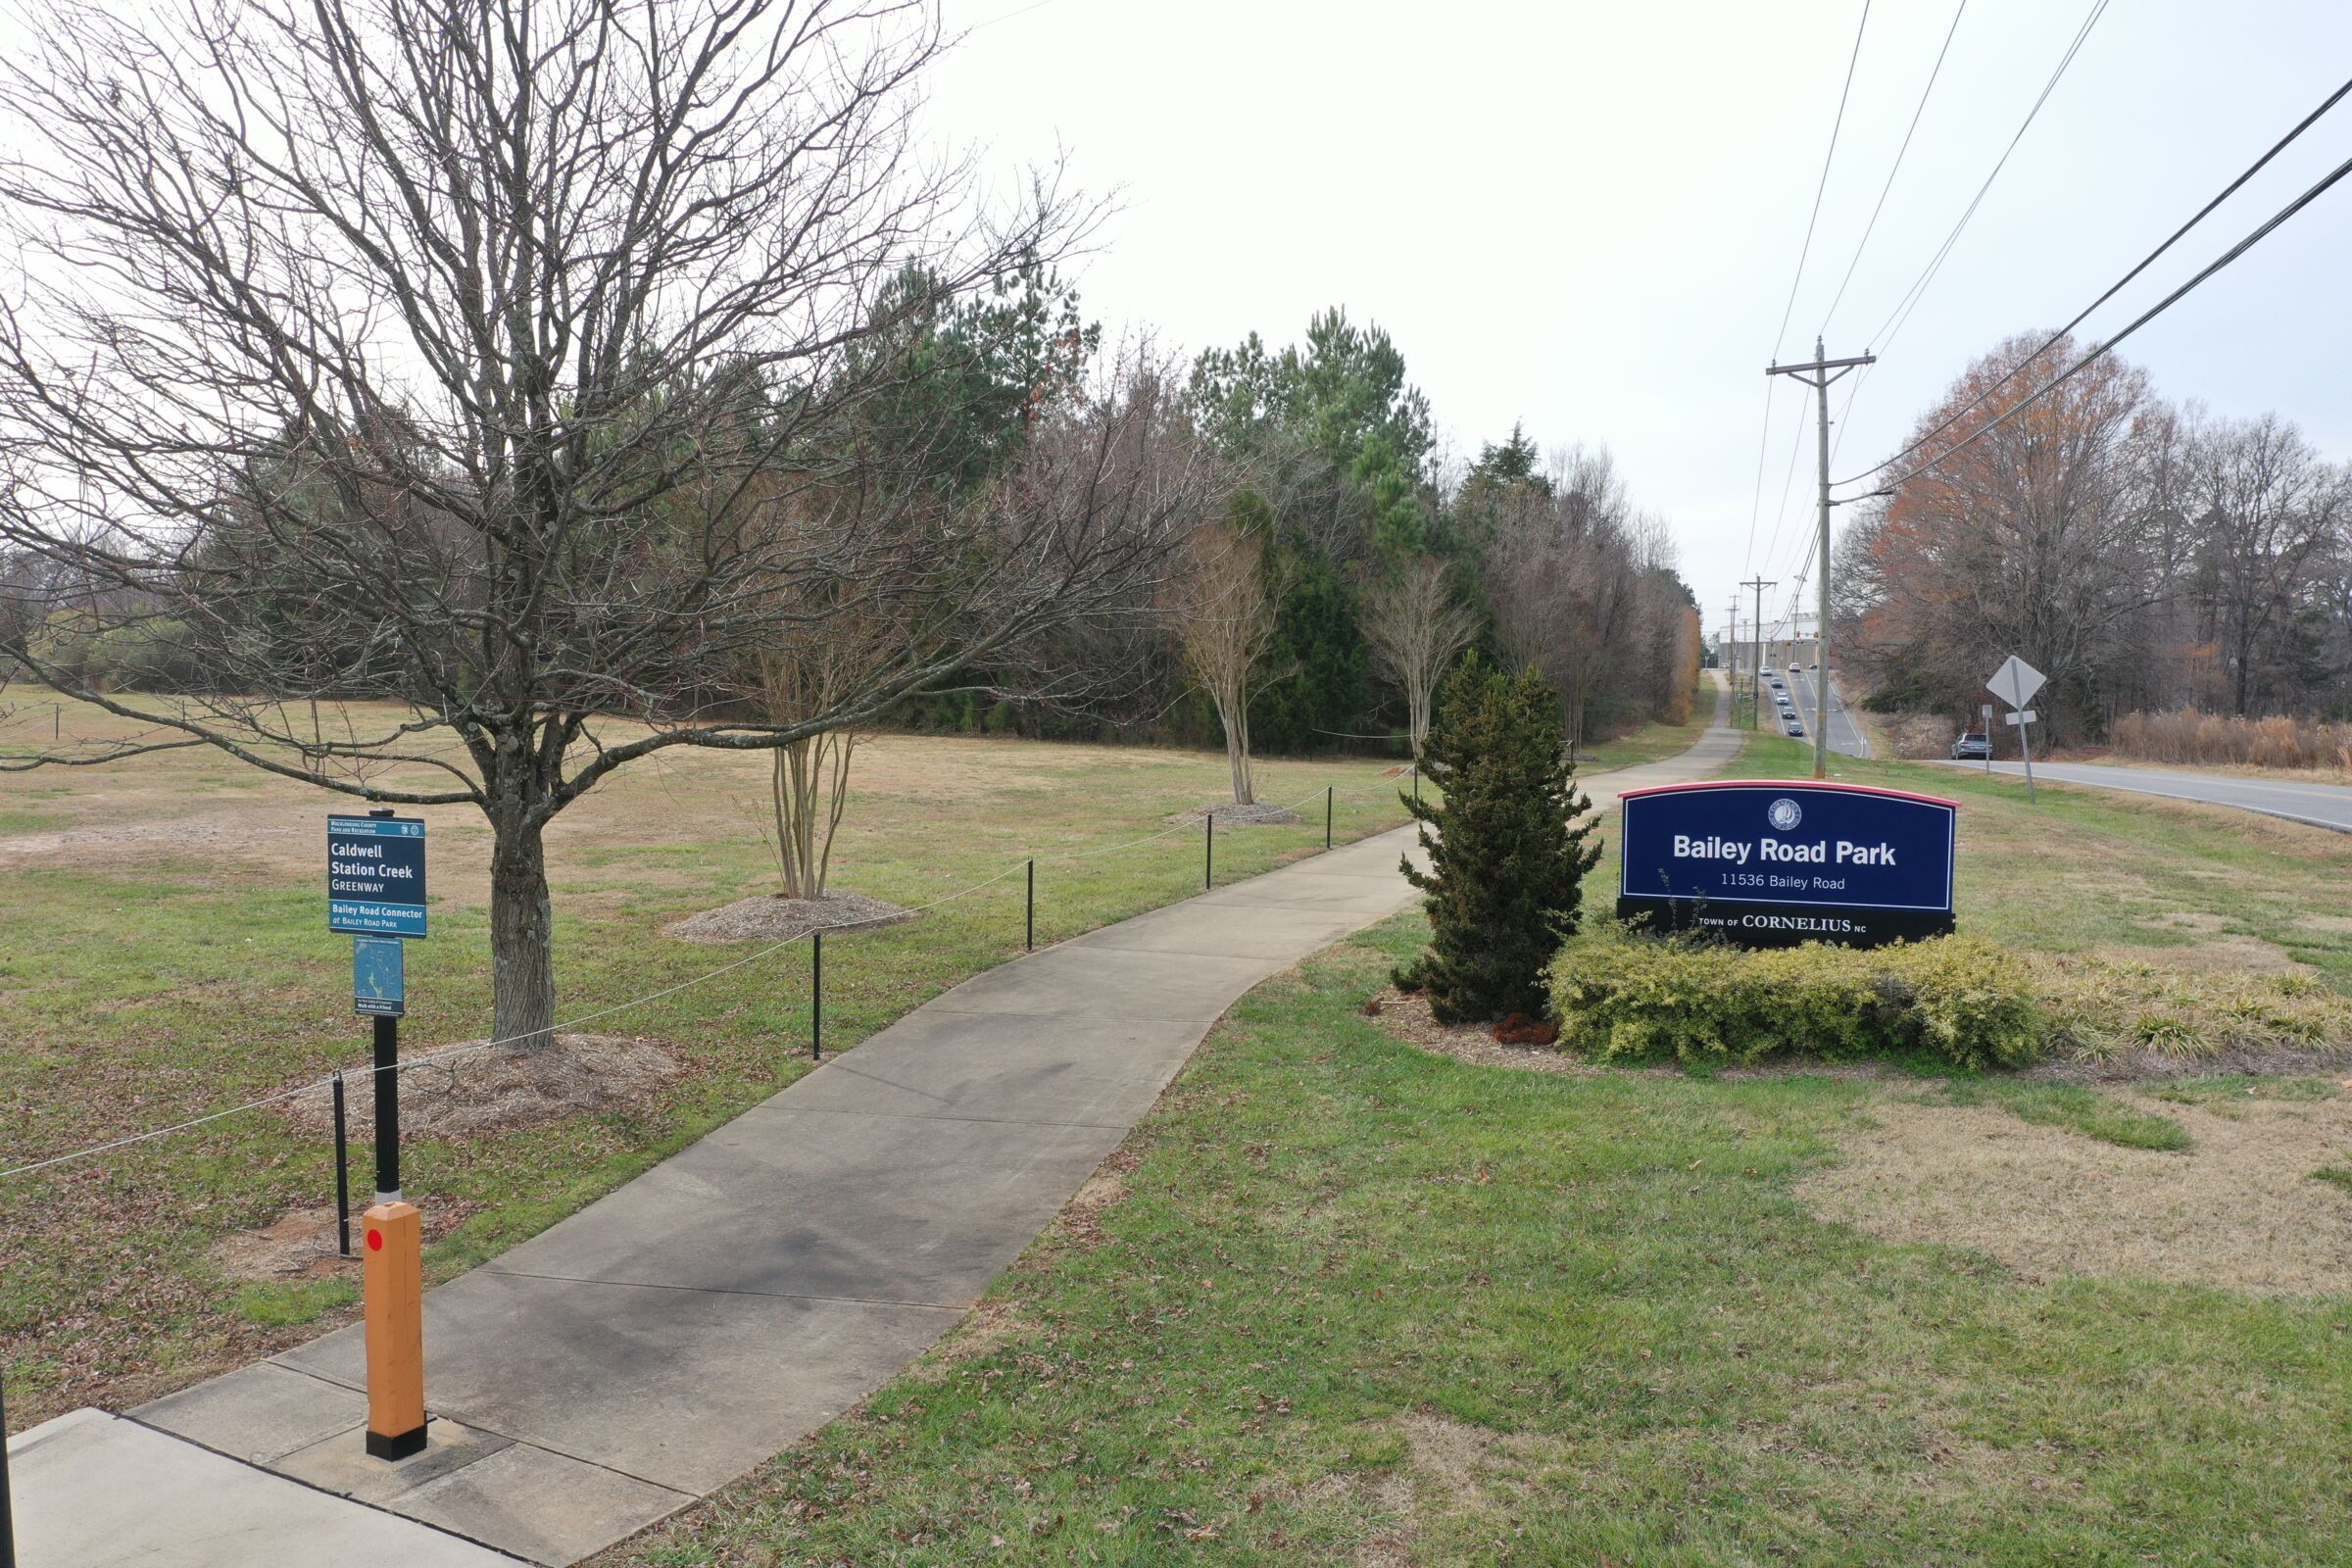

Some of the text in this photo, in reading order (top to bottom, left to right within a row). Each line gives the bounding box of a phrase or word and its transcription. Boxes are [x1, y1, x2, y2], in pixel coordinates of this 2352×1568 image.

[331, 843, 382, 858] Caldwell
[1674, 835, 1896, 865] Bailey Road Park
[331, 861, 413, 878] Station Creek
[331, 879, 384, 893] GREENWAY
[1721, 873, 1845, 890] 11536 Bailey Road
[332, 904, 422, 918] Bailey Road Connector
[1742, 914, 1851, 931] CORNELIUS
